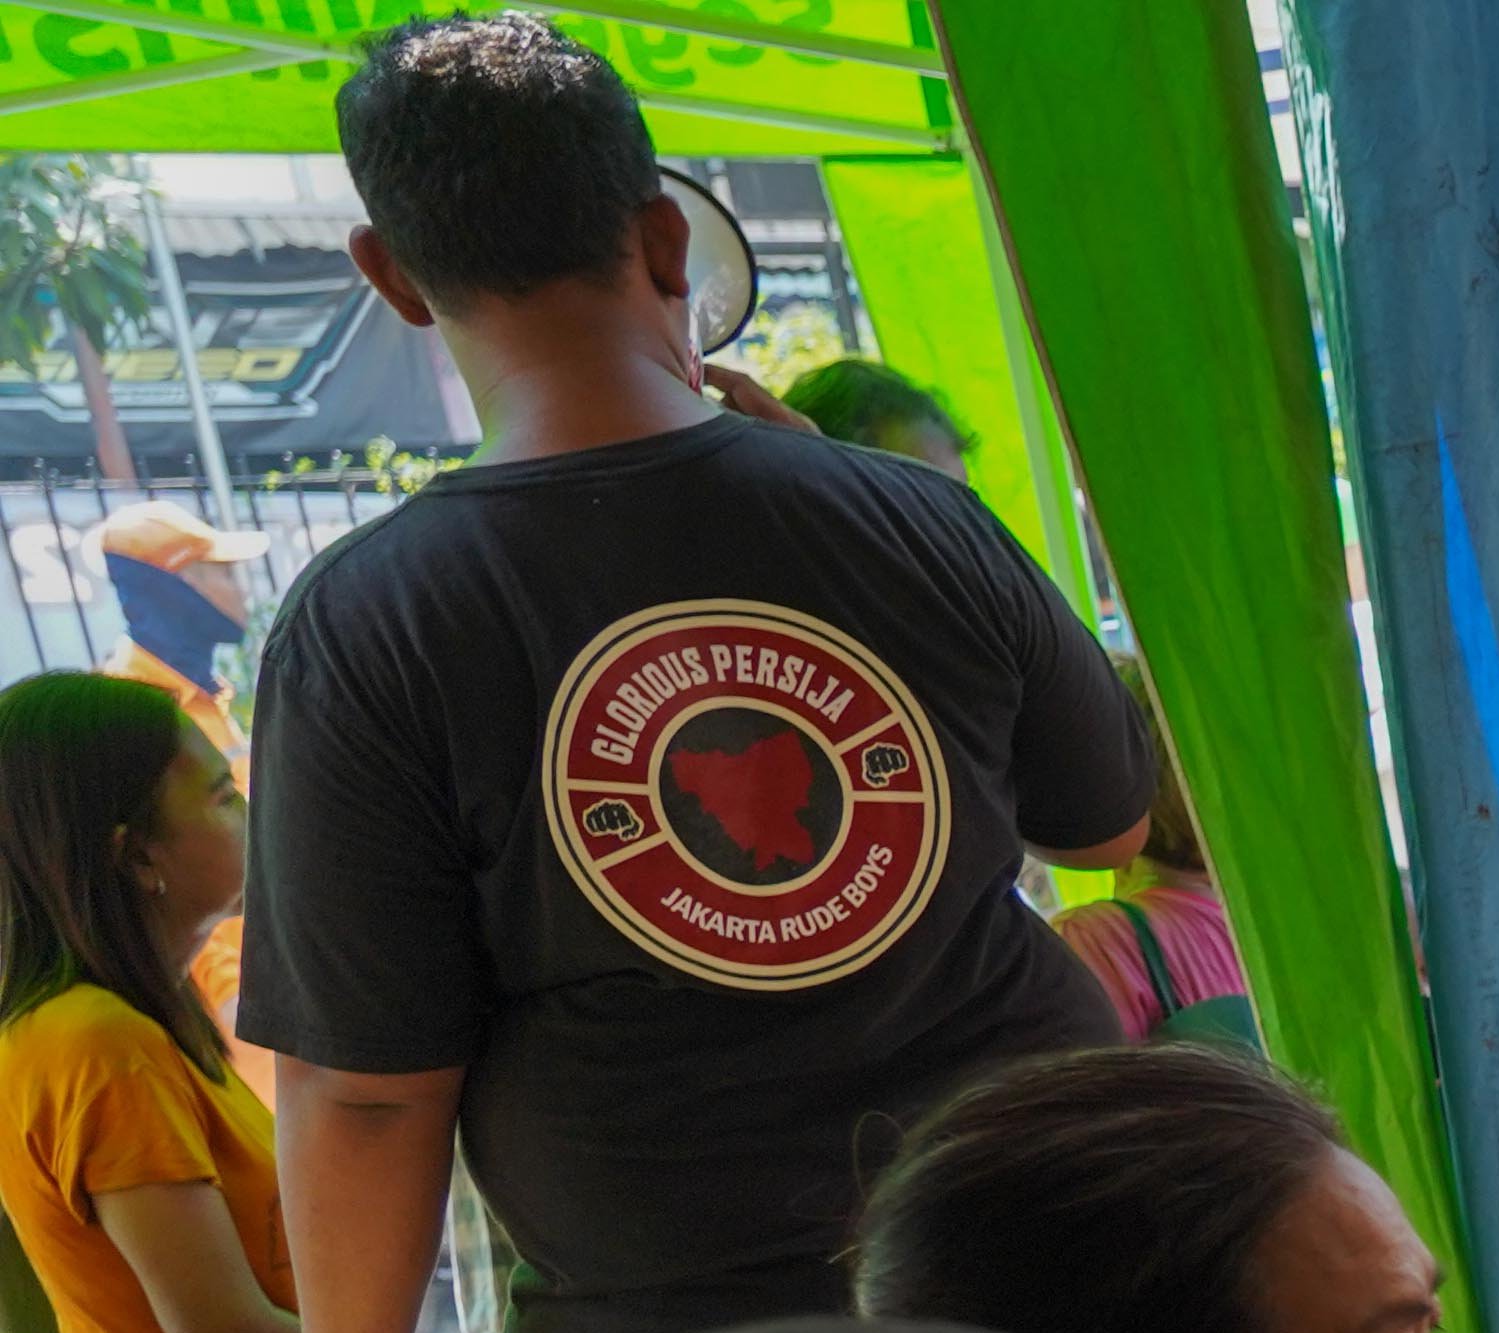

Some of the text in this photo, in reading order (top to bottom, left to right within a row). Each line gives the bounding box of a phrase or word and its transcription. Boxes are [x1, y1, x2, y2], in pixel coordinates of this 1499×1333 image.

[591, 643, 855, 766] GLORIOUS PERSIJA
[661, 843, 893, 944] JAKARTA RUDE BOYS
